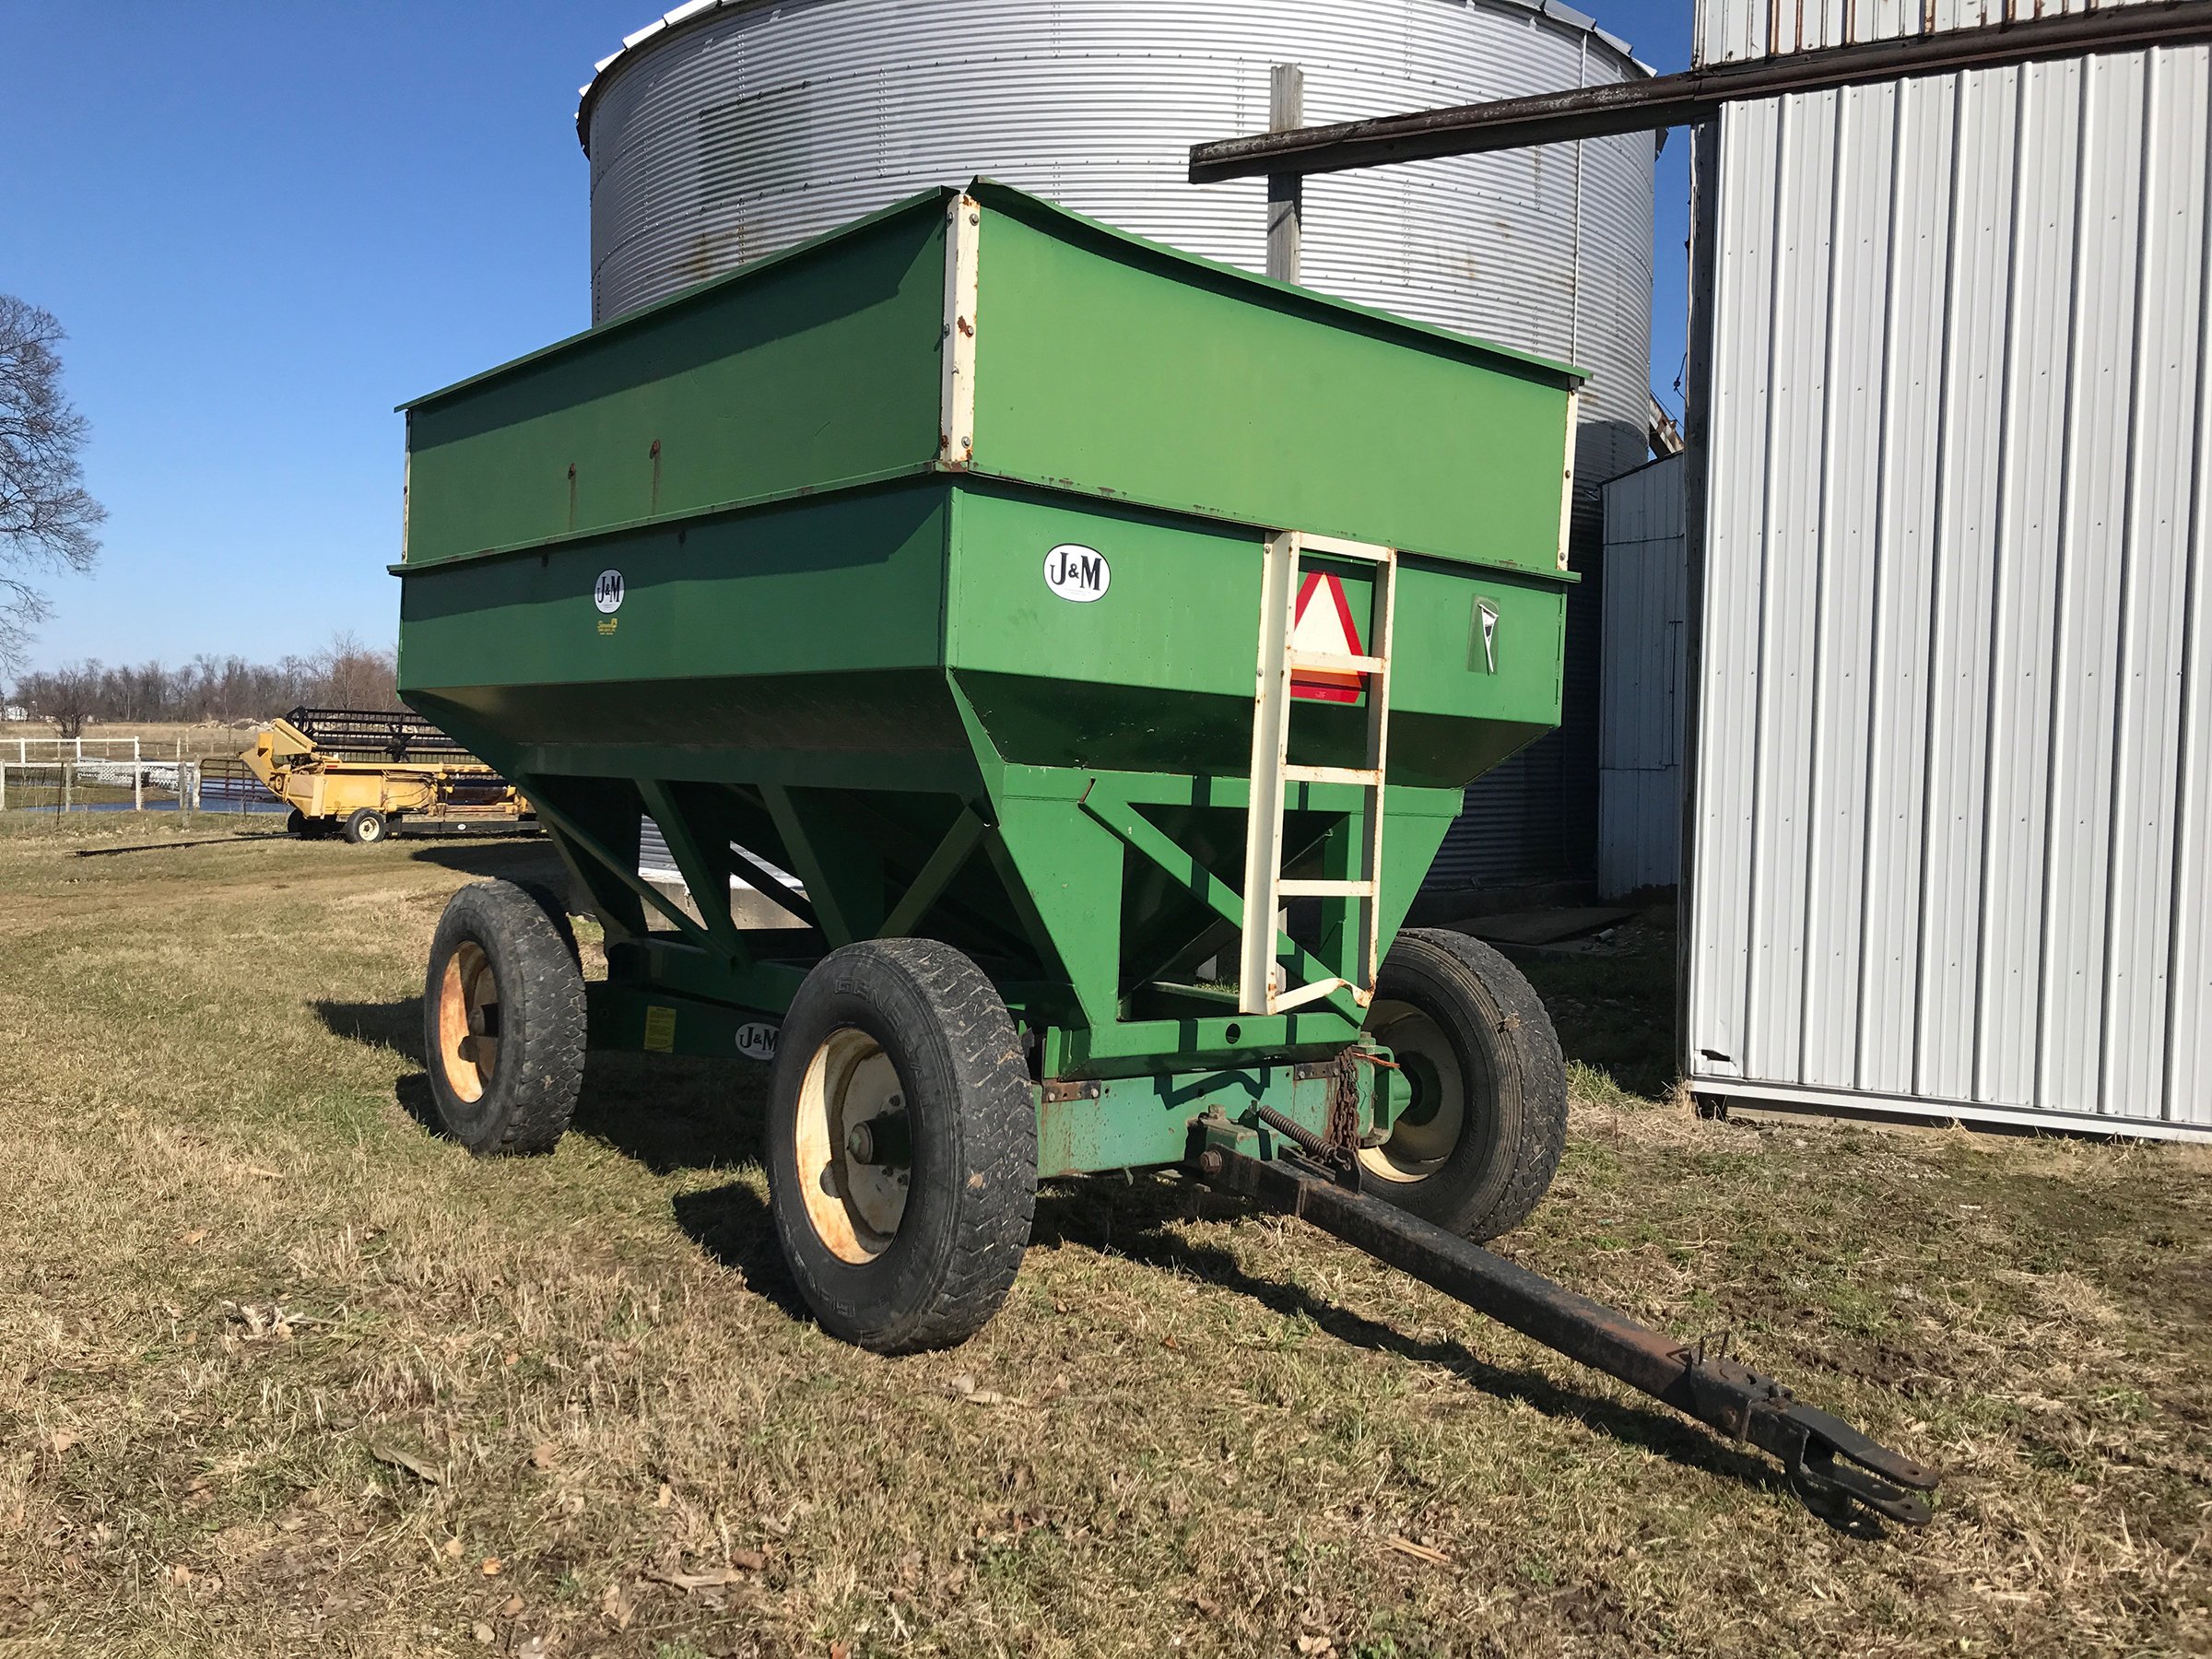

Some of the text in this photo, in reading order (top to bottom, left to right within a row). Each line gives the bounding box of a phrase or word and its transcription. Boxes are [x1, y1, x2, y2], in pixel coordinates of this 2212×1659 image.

[1050, 551, 1102, 591] J&M
[597, 575, 621, 604] J&M
[739, 1026, 781, 1052] J&M
